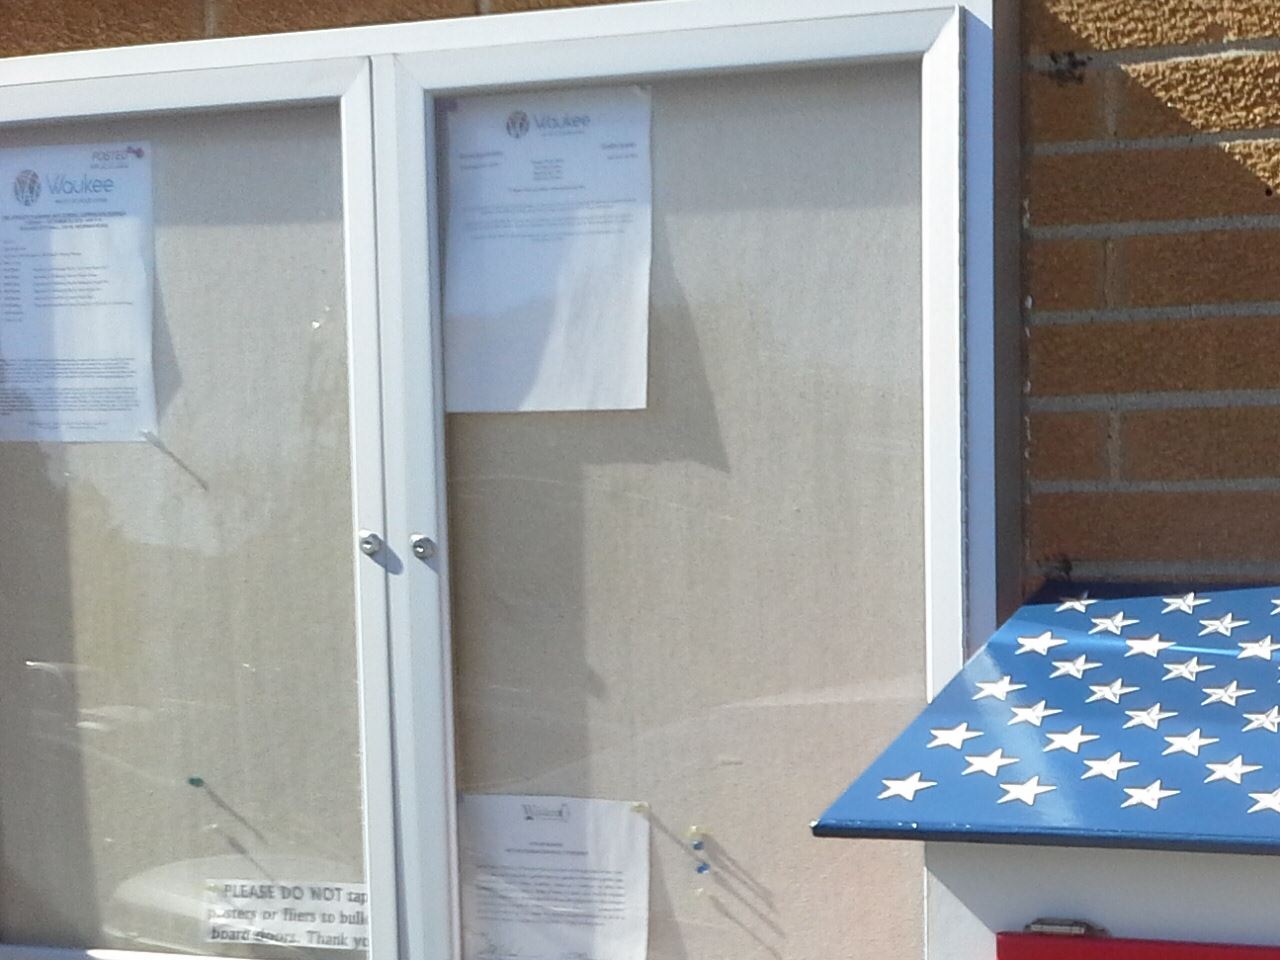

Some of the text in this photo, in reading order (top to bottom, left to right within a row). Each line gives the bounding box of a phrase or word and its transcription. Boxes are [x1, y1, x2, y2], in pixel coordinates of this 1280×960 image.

[46, 174, 115, 195] Waukee
[224, 884, 274, 899] PLEASE
[280, 886, 305, 900] DO
[311, 887, 343, 902] NOT
[262, 910, 278, 921] or
[321, 911, 336, 923] to
[211, 926, 250, 941] board
[306, 930, 348, 947] Thank
